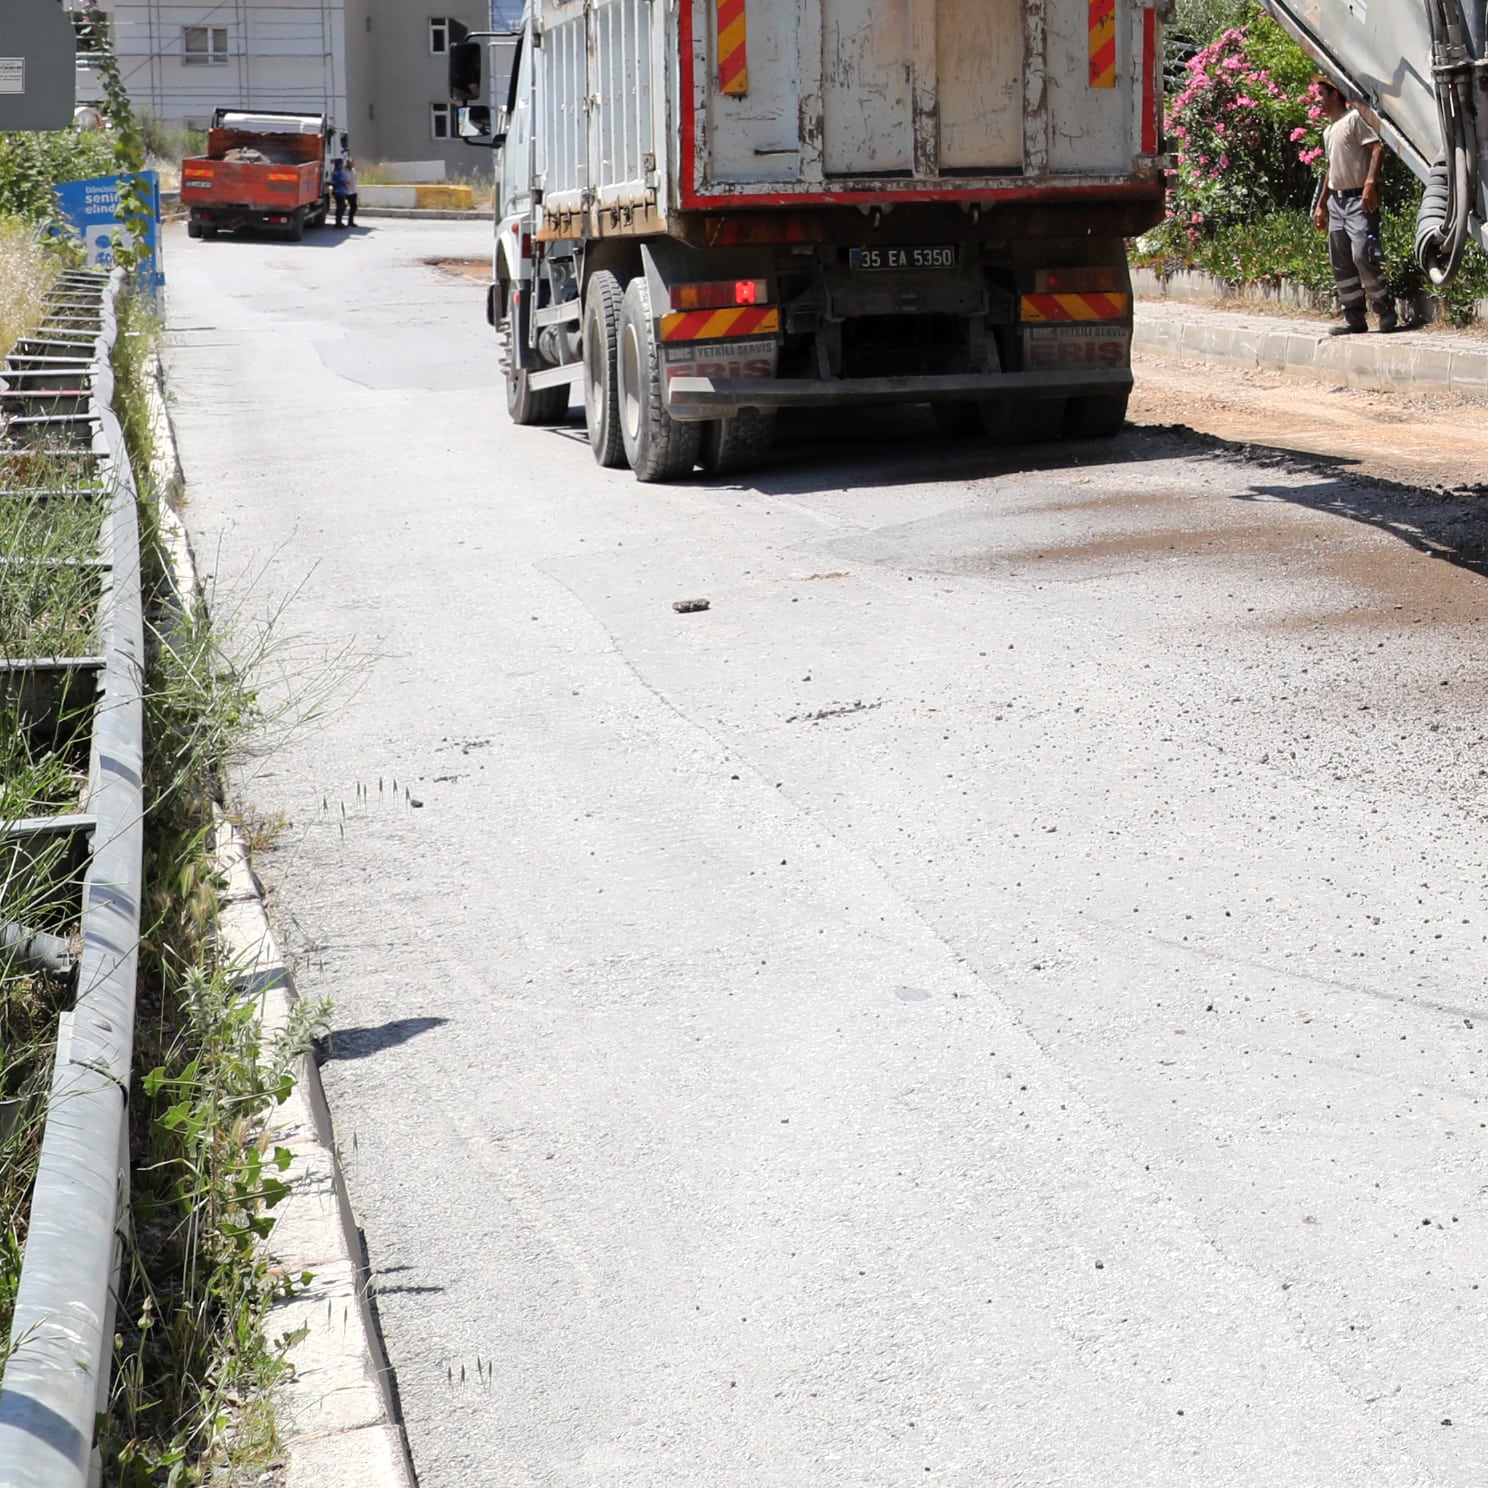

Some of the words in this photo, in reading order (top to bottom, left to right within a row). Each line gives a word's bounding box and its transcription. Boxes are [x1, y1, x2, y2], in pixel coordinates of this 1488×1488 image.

[85, 203, 116, 214] elind
[862, 251, 880, 267] 35
[888, 250, 907, 266] EA
[913, 249, 951, 265] 5350
